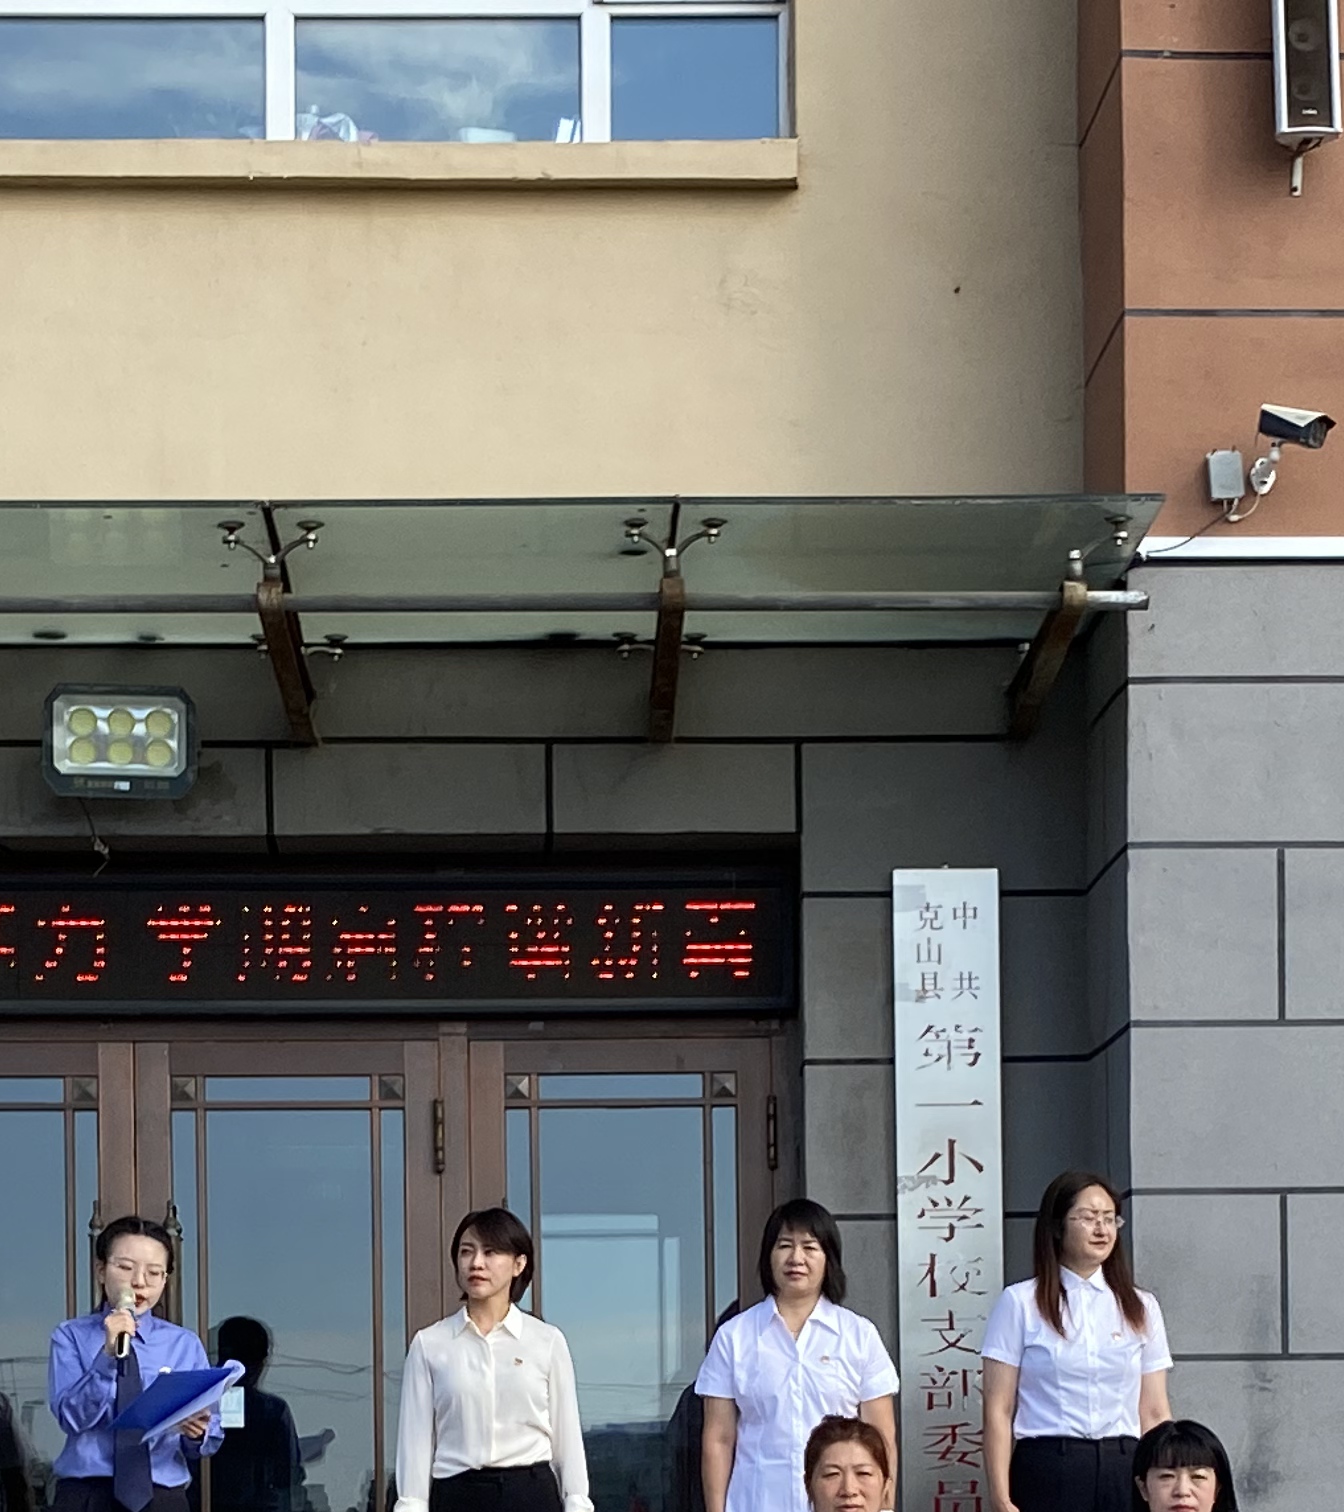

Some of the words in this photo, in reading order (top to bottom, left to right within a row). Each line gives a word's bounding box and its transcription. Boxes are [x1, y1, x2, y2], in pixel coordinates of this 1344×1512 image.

[915, 901, 945, 1002] 克山县
[951, 900, 981, 1001] 中共
